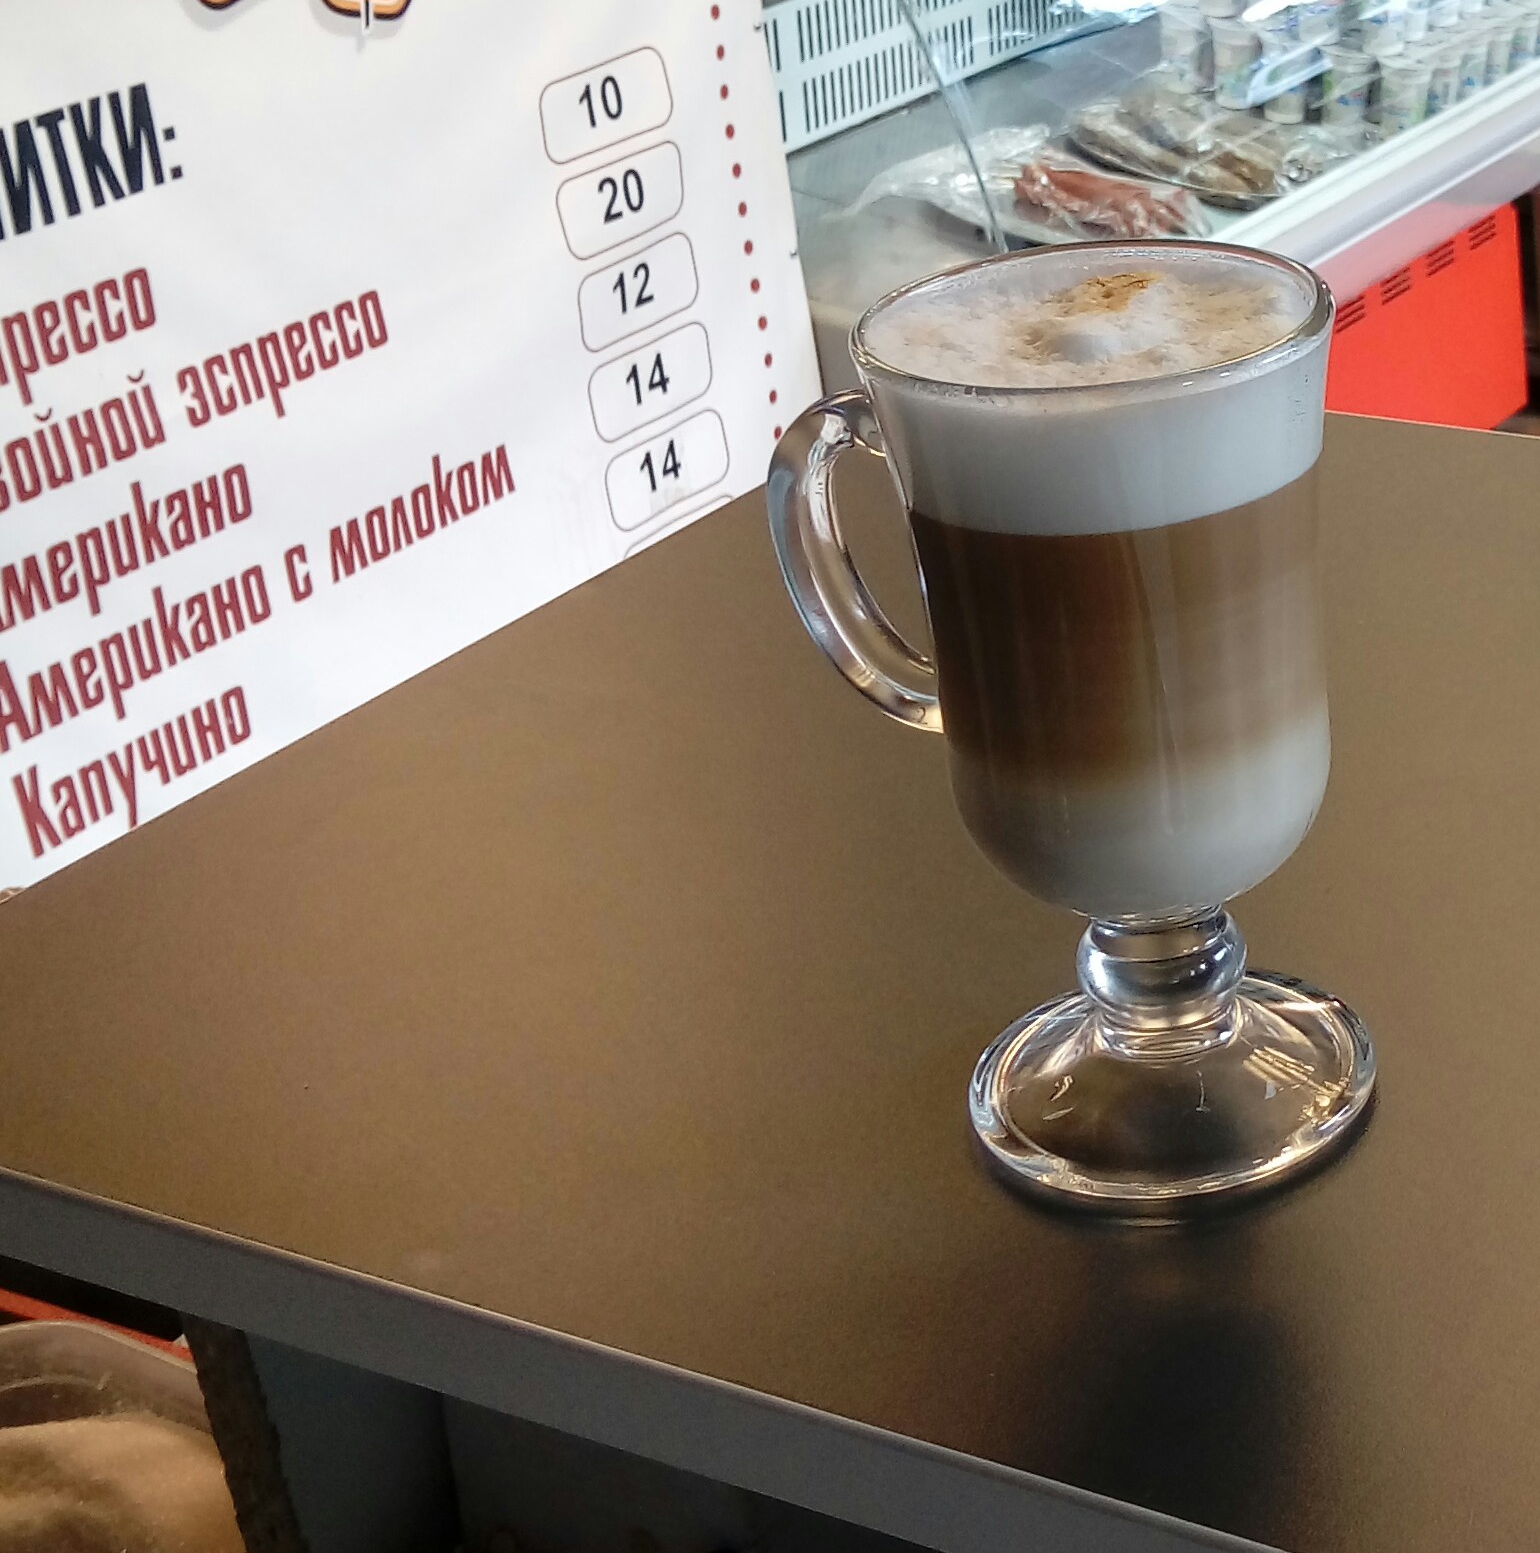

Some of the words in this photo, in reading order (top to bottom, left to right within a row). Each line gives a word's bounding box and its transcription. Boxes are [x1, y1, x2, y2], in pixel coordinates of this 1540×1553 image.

[0, 82, 184, 241] ИТКИ:
[578, 75, 623, 128] 10
[597, 168, 645, 223] 20
[0, 267, 156, 406] рессо
[612, 262, 655, 314] 12
[176, 290, 388, 419] эспрессо
[626, 352, 671, 406] 14
[639, 439, 682, 492] 14
[0, 463, 252, 633] мерикано
[0, 586, 271, 754] Американо
[283, 543, 314, 604] с
[329, 443, 517, 584] молоком
[11, 686, 252, 859] Капучино
